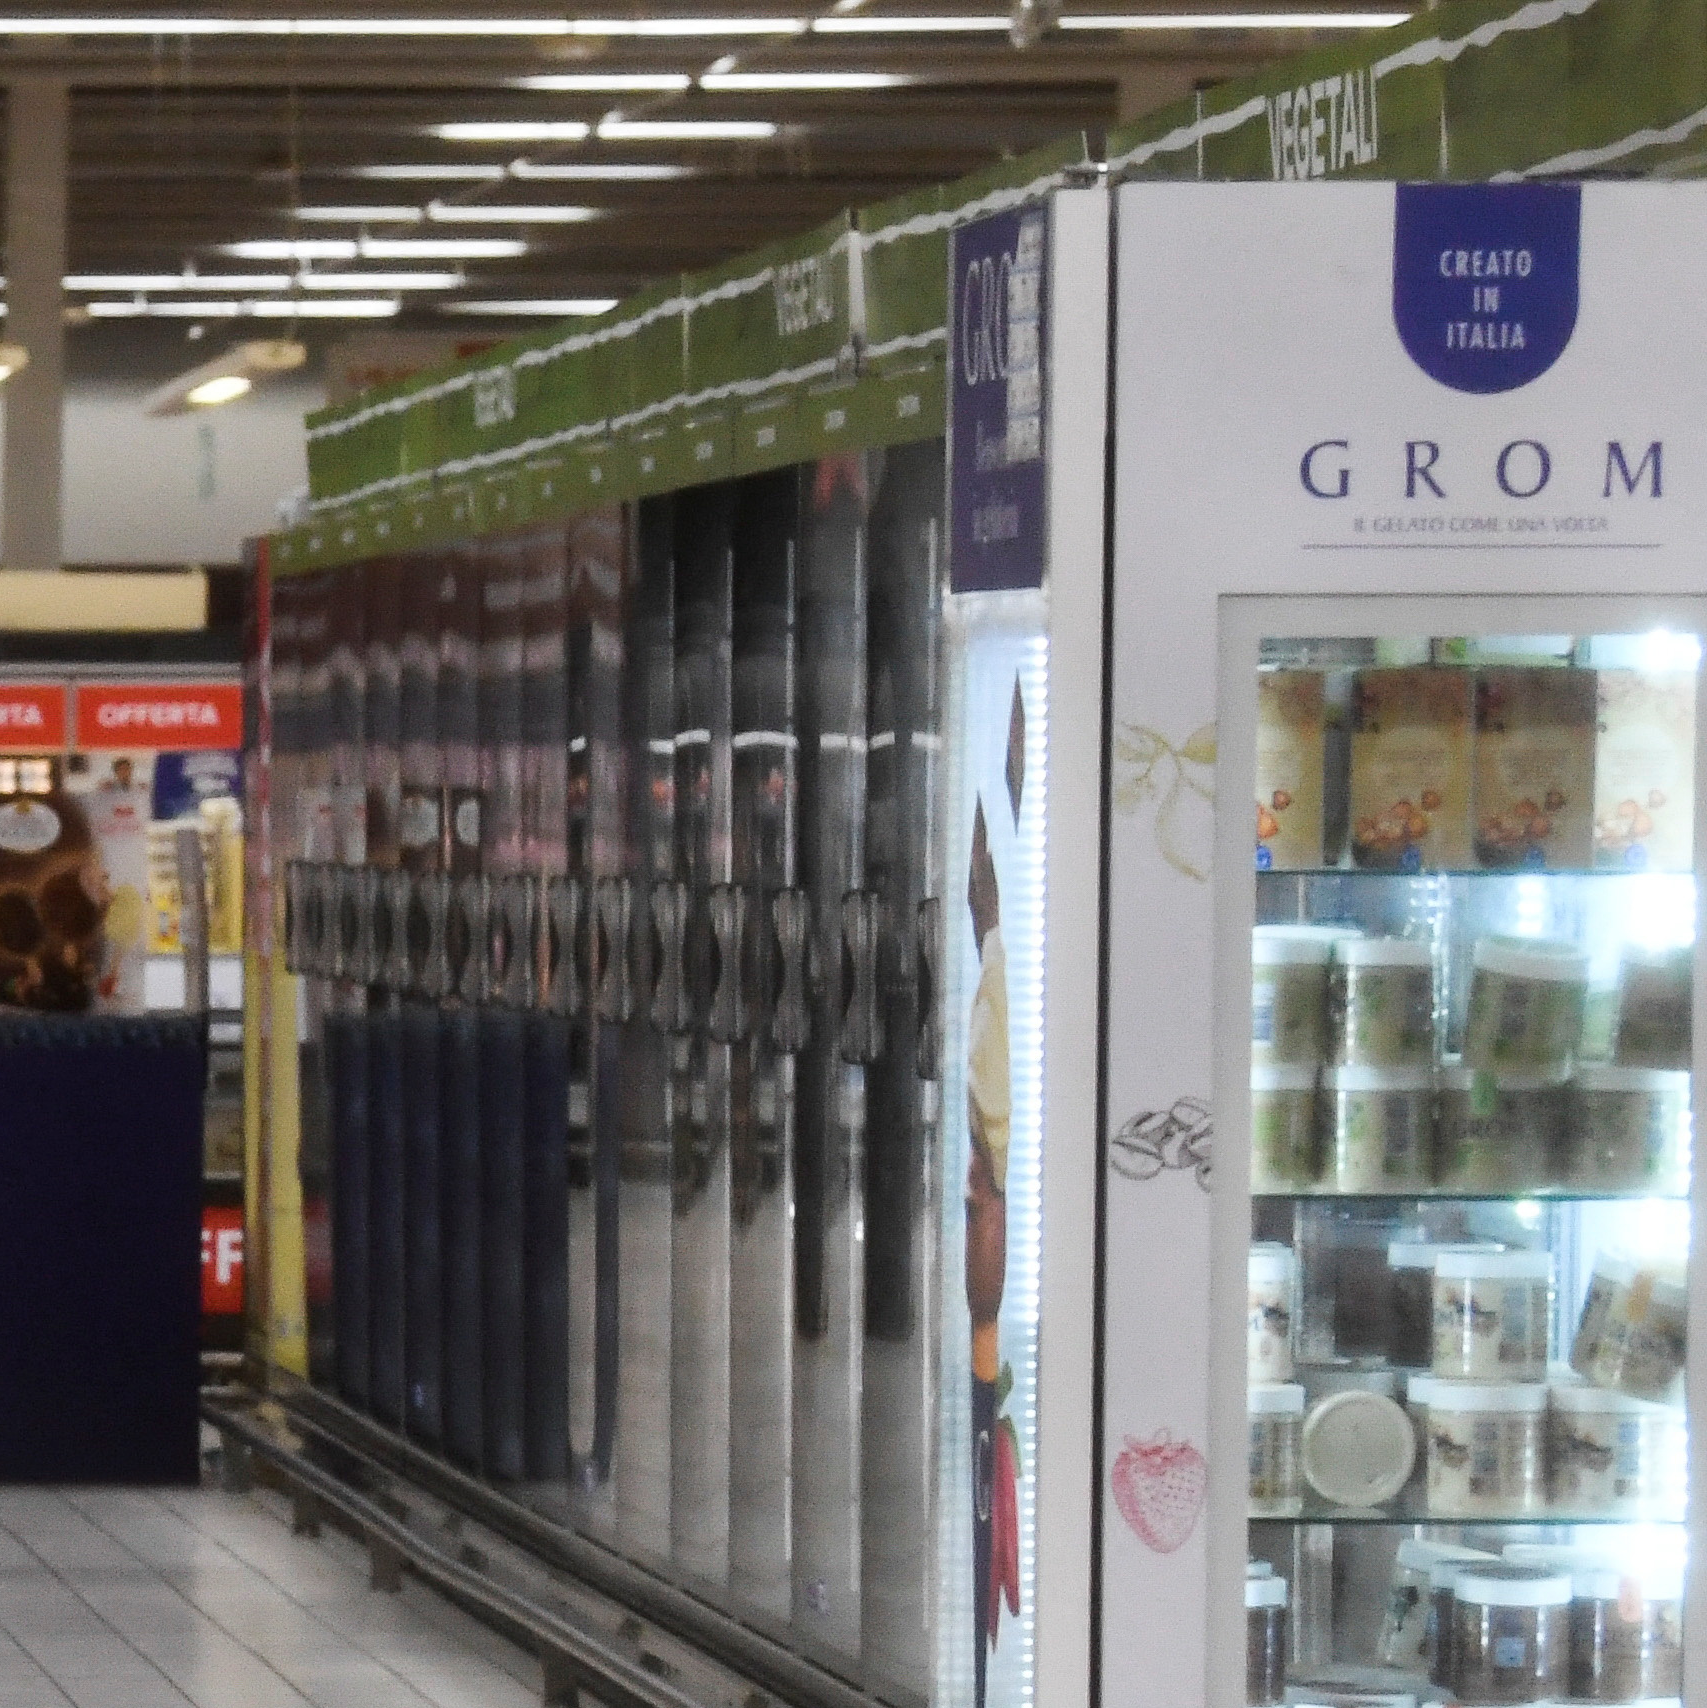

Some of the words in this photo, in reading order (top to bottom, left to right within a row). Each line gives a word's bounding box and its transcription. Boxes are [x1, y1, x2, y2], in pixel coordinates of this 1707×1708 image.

[1268, 66, 1378, 181] VEGETALI
[1440, 250, 1532, 277] CREATO
[1473, 286, 1500, 313] IN
[1445, 322, 1526, 350] ITALIA
[1299, 440, 1664, 499] GROM
